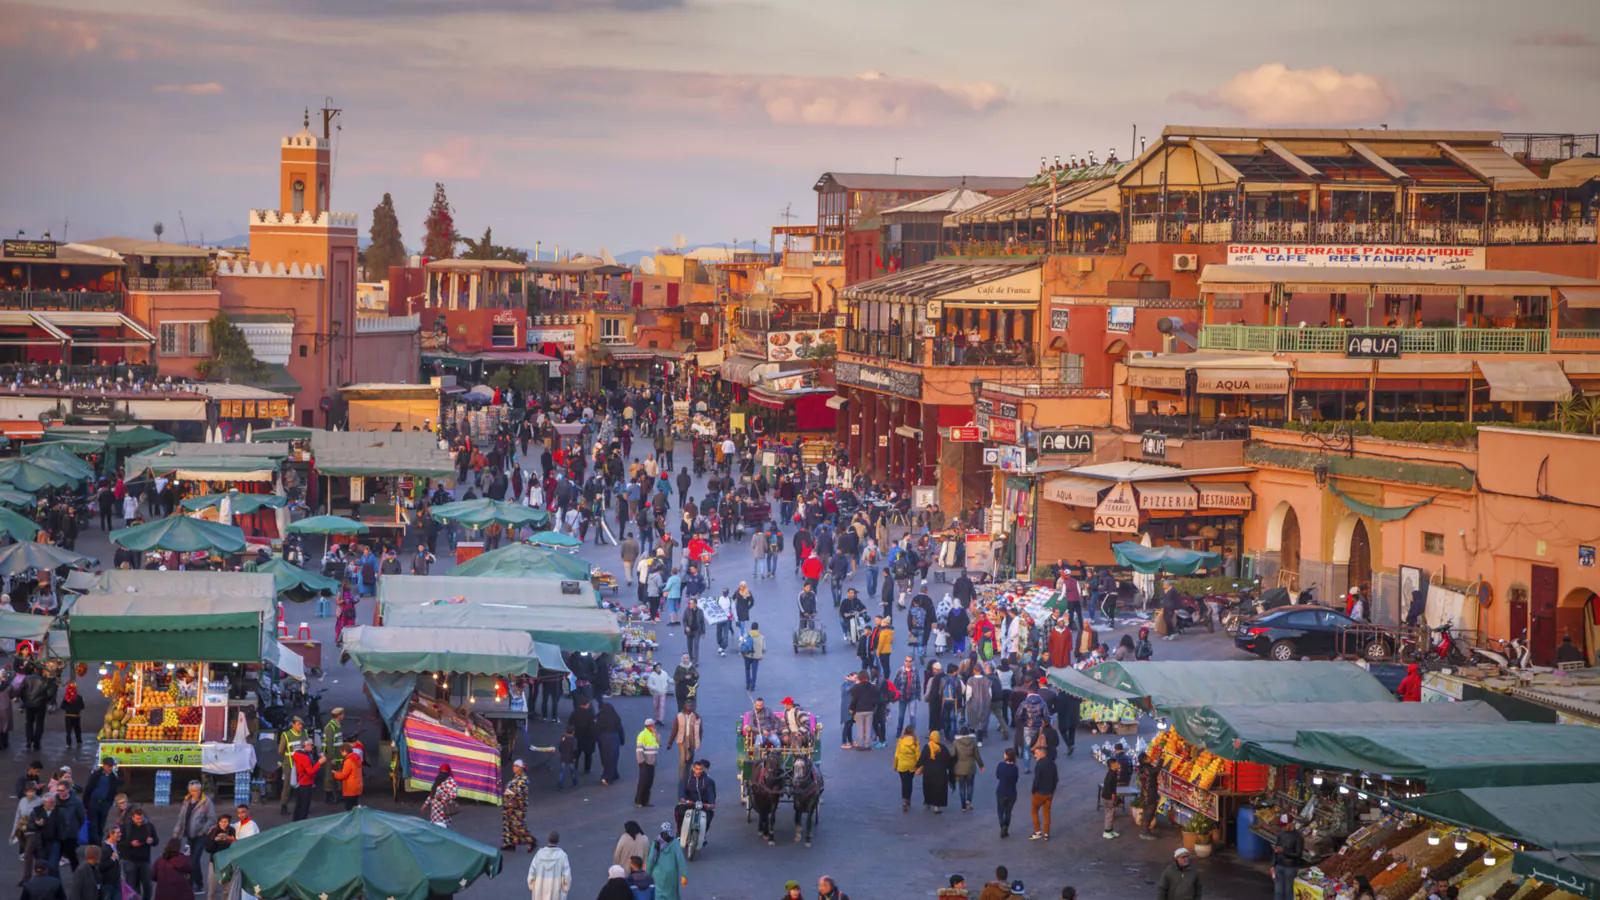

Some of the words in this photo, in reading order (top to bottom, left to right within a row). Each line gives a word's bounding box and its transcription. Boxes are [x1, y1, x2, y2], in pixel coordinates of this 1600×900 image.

[1229, 246, 1280, 255] GRAND
[1284, 247, 1359, 255] TERRASSE
[1363, 247, 1475, 257] PANORAMIQUE
[1234, 254, 1255, 262] HOTEL
[1265, 254, 1308, 262] CAFE
[1328, 255, 1437, 263] RESTAURANT
[977, 285, 994, 296] Café
[995, 286, 1004, 294] de
[1006, 286, 1032, 295] France
[1348, 337, 1398, 355] AQUA
[1215, 380, 1251, 391] AQUA
[1254, 382, 1286, 390] RESTAURANT
[1041, 434, 1091, 450] AQUA
[1142, 438, 1165, 455] AQUA
[1056, 489, 1073, 501] AQUA
[1142, 494, 1194, 508] PIZZERIA
[1200, 492, 1252, 507] RESTAURANT
[1104, 504, 1133, 513] TERRASSE
[1095, 516, 1137, 529] AQUA
[173, 754, 183, 764] 48
